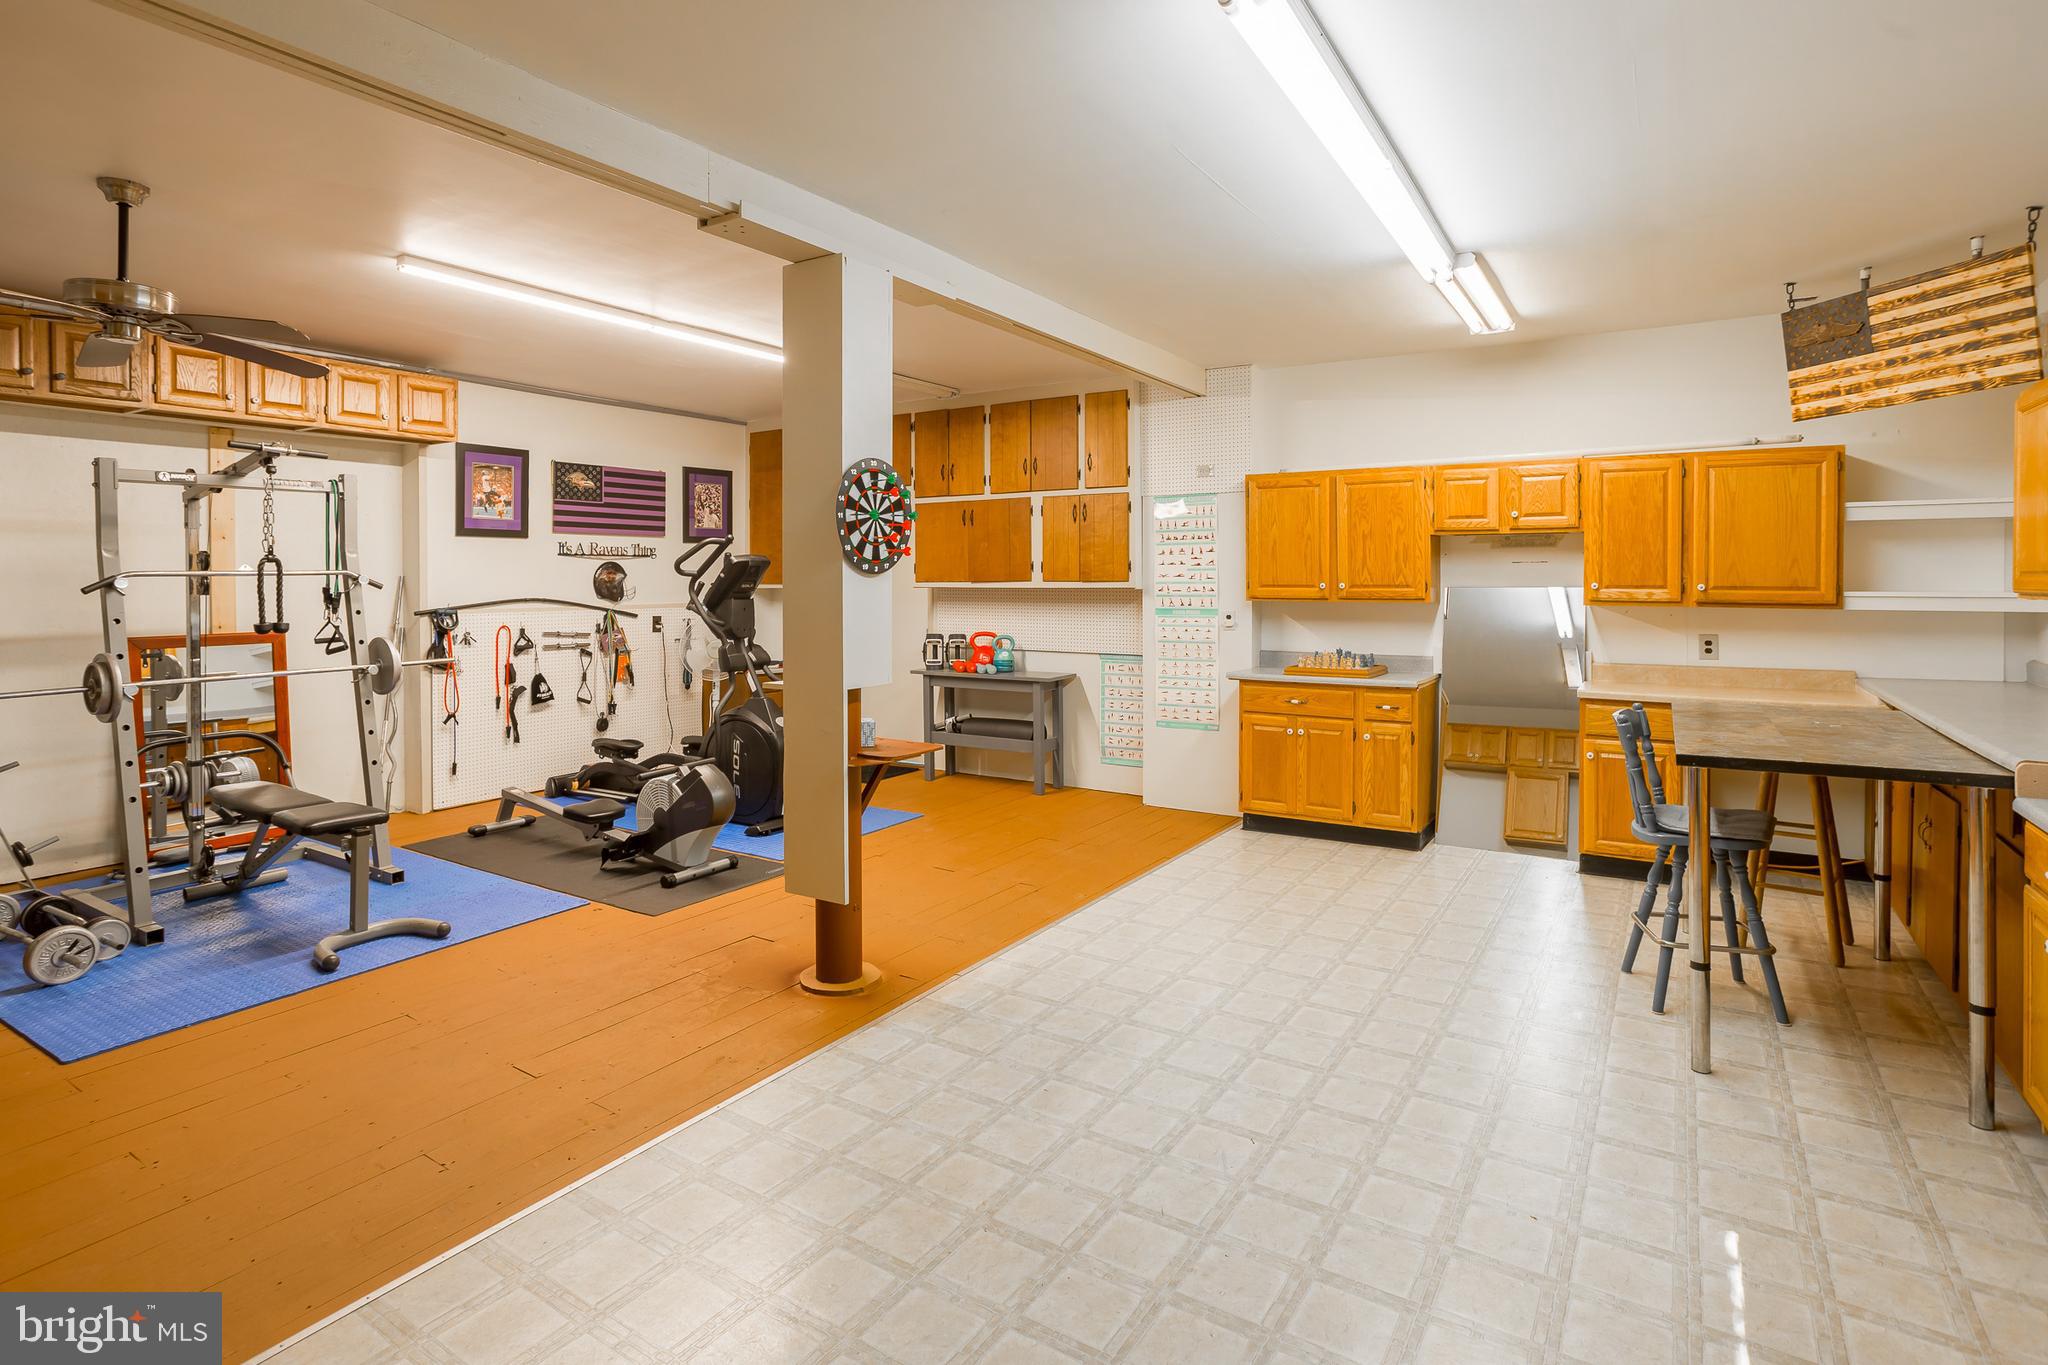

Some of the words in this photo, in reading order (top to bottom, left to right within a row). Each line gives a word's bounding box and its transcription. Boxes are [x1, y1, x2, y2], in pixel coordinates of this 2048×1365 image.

[558, 541, 573, 555] It's
[575, 542, 585, 555] A
[590, 542, 629, 556] Ravens
[631, 543, 657, 559] Thing
